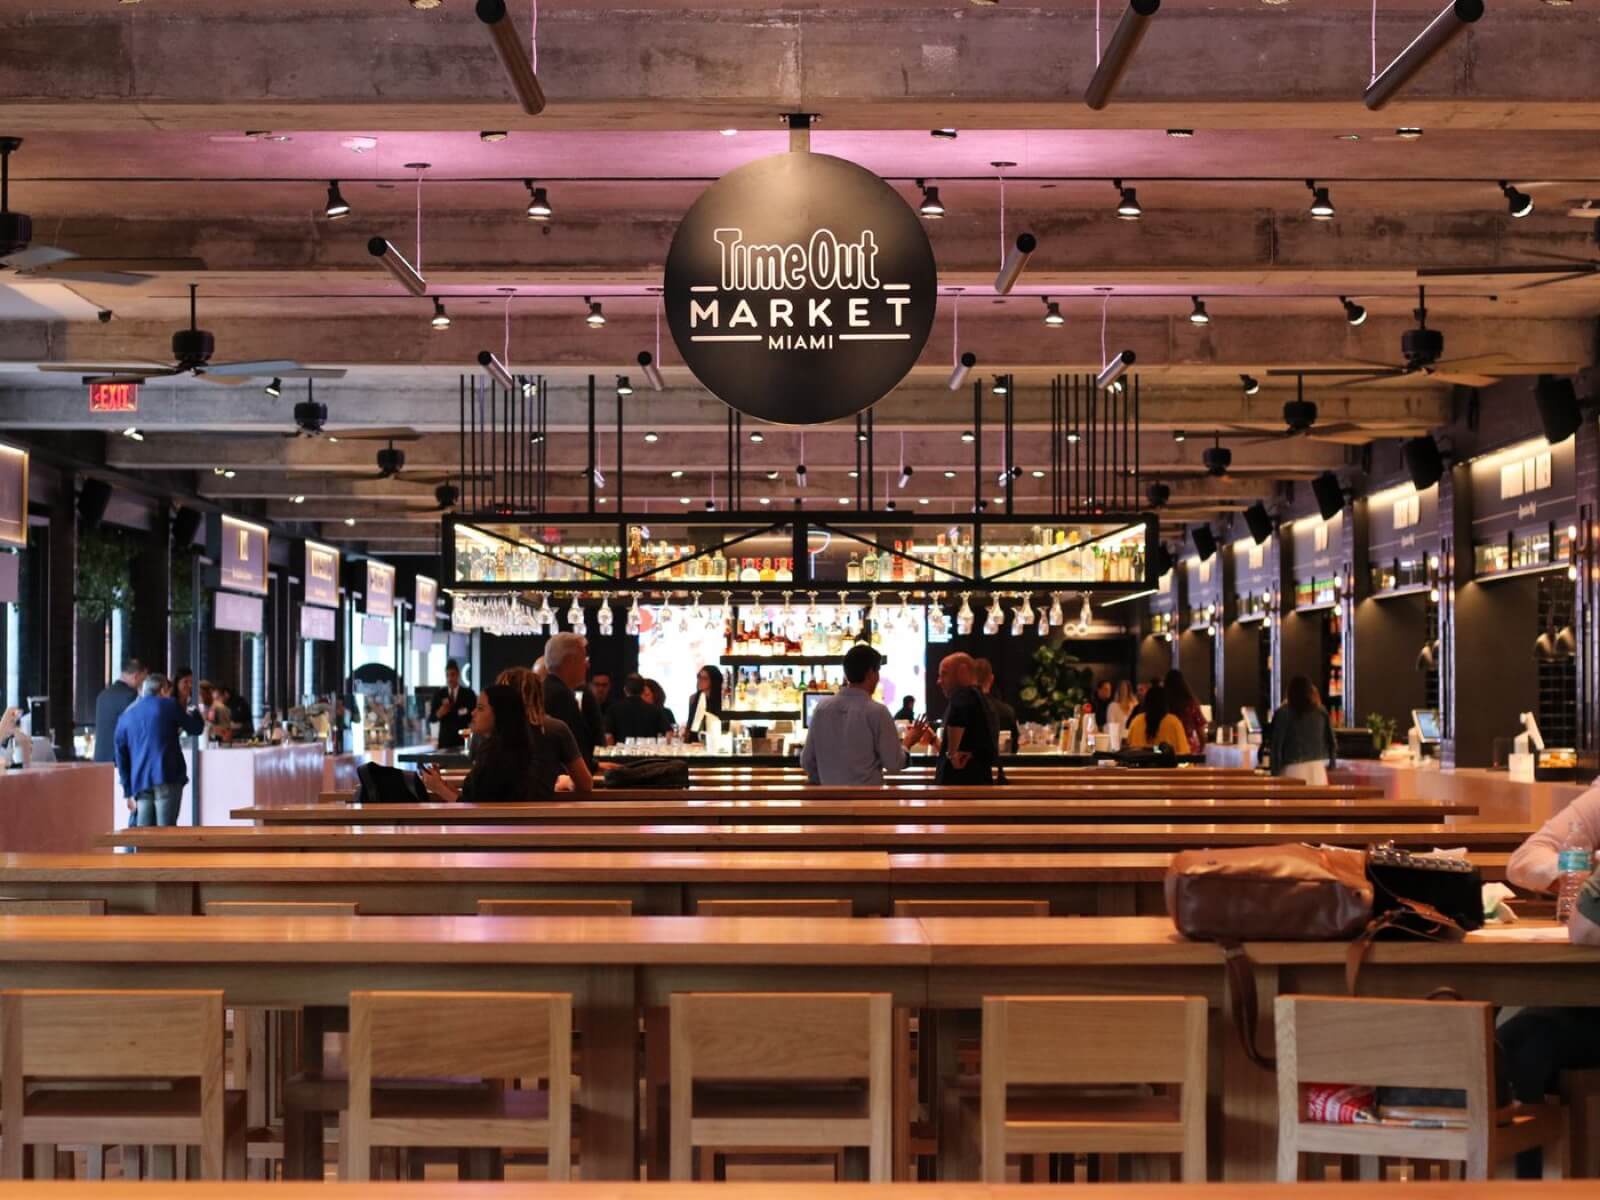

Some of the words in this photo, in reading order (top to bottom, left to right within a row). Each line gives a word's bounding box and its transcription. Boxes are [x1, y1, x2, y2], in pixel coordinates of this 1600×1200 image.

[690, 297, 911, 328] MARKET
[768, 334, 833, 350] MIAMI
[100, 384, 129, 409] EXIT
